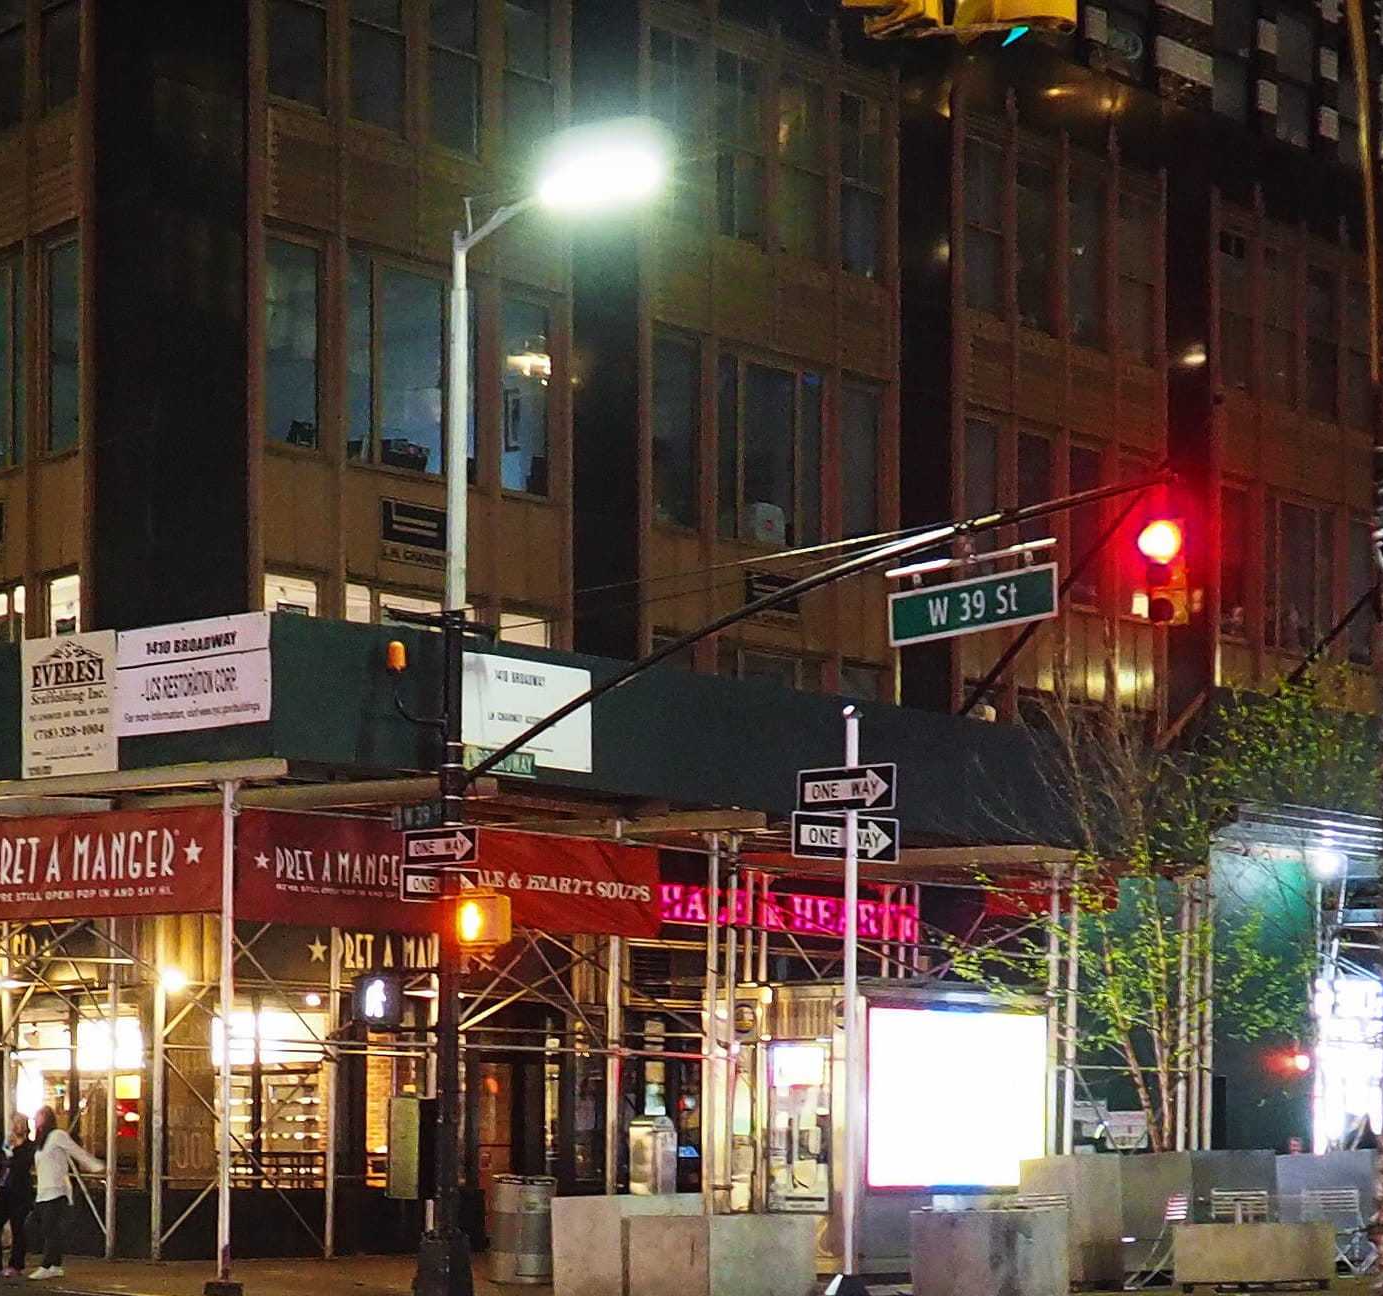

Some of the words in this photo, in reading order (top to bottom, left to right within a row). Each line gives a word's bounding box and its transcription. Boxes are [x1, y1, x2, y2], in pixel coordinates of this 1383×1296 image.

[928, 596, 949, 627] W
[959, 589, 986, 621] 39
[996, 582, 1018, 614] St
[145, 641, 171, 656] 1410
[173, 631, 237, 654] BROADWAY
[32, 658, 105, 688] EVEREST
[811, 782, 839, 800] ONE
[851, 780, 879, 796] WAY
[414, 842, 436, 854] ONE
[809, 828, 839, 845] ONE
[46, 836, 61, 882] A
[72, 827, 175, 882] MANGER
[275, 847, 315, 881] PRET
[321, 852, 331, 882] A
[338, 850, 400, 887] MANGE
[15, 892, 42, 902] STILL
[76, 889, 97, 899] POP
[113, 886, 134, 898] AND
[137, 886, 155, 896] SAY
[413, 878, 436, 891] ONE
[478, 869, 506, 888] ALE
[508, 872, 522, 889] &
[526, 874, 593, 897] HEARTY
[595, 881, 651, 902] SOUPS
[331, 931, 375, 969] PRET
[383, 935, 394, 968] A
[403, 934, 440, 969] MAN
